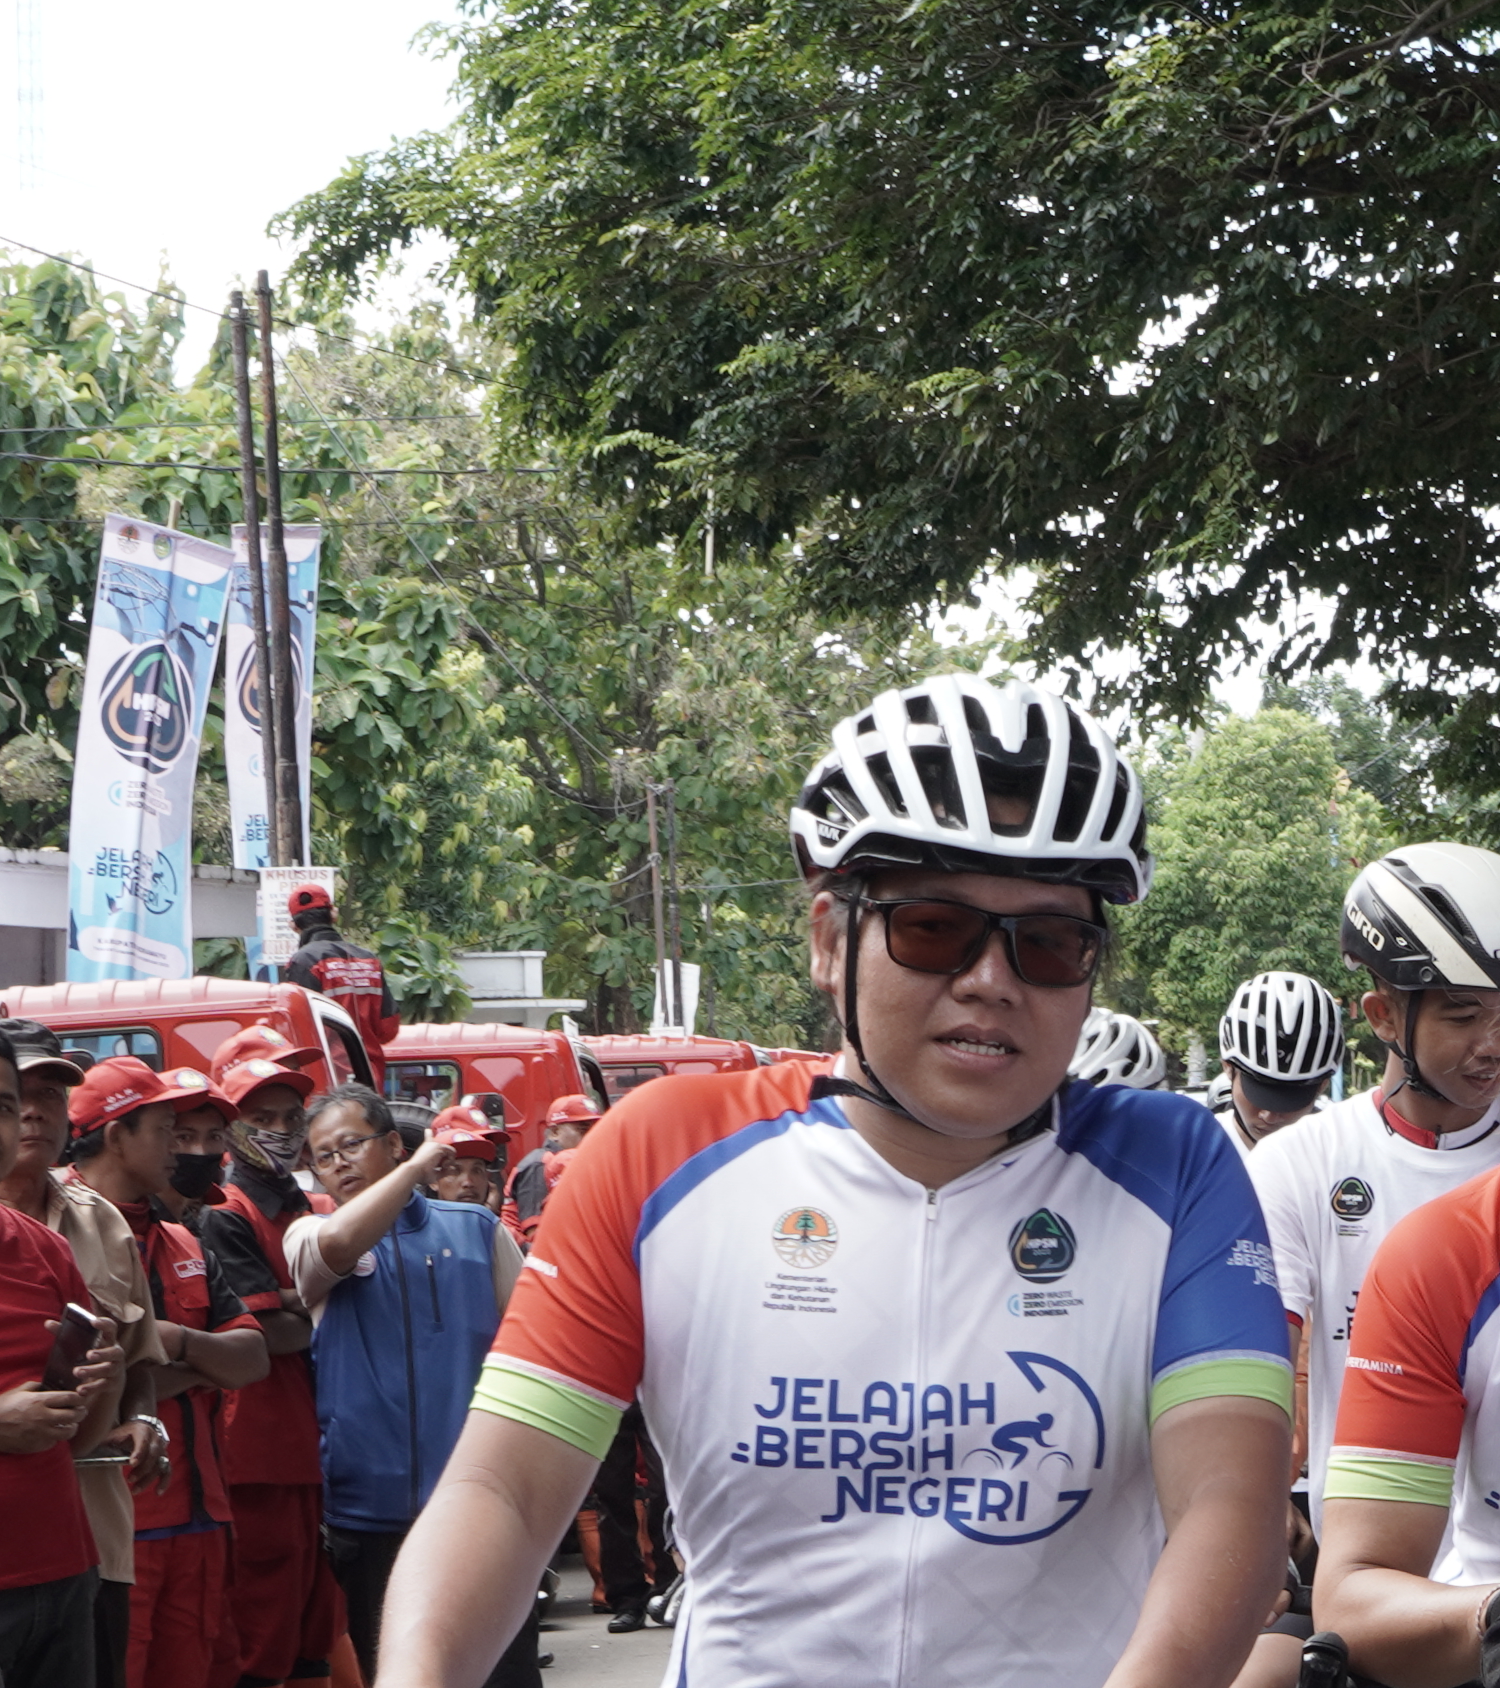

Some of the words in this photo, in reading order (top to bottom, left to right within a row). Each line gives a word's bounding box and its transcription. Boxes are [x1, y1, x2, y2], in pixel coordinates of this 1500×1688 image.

[266, 869, 329, 880] KHUSUS
[1345, 900, 1385, 951] GIRO
[754, 1376, 996, 1431] JELAJAH
[754, 1425, 955, 1473] BERSIH
[820, 1475, 1029, 1523] NEGERI
